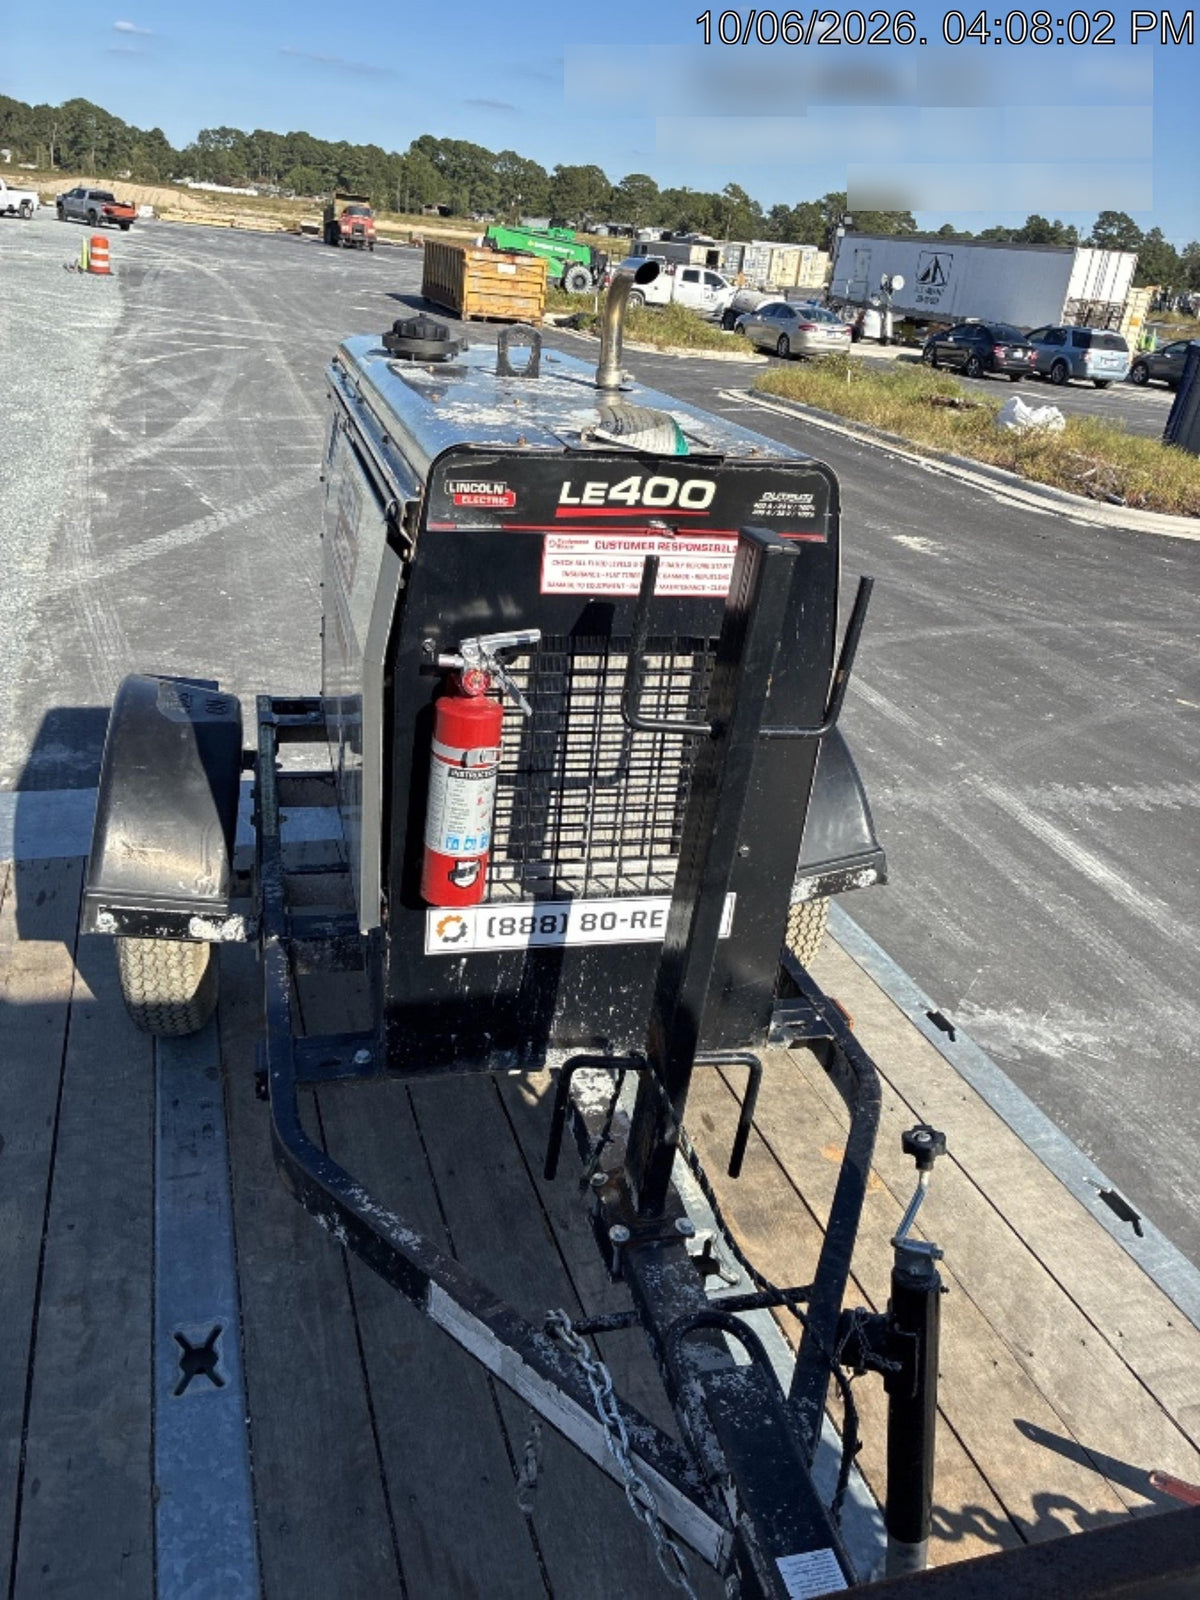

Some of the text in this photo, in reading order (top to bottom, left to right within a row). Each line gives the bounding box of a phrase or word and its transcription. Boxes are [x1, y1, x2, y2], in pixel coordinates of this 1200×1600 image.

[449, 482, 504, 494] LINCOLN
[558, 475, 717, 510] LE400
[461, 495, 509, 504] ELECTRIC
[594, 540, 655, 550] CUSTOMER
[486, 912, 569, 938] (888)
